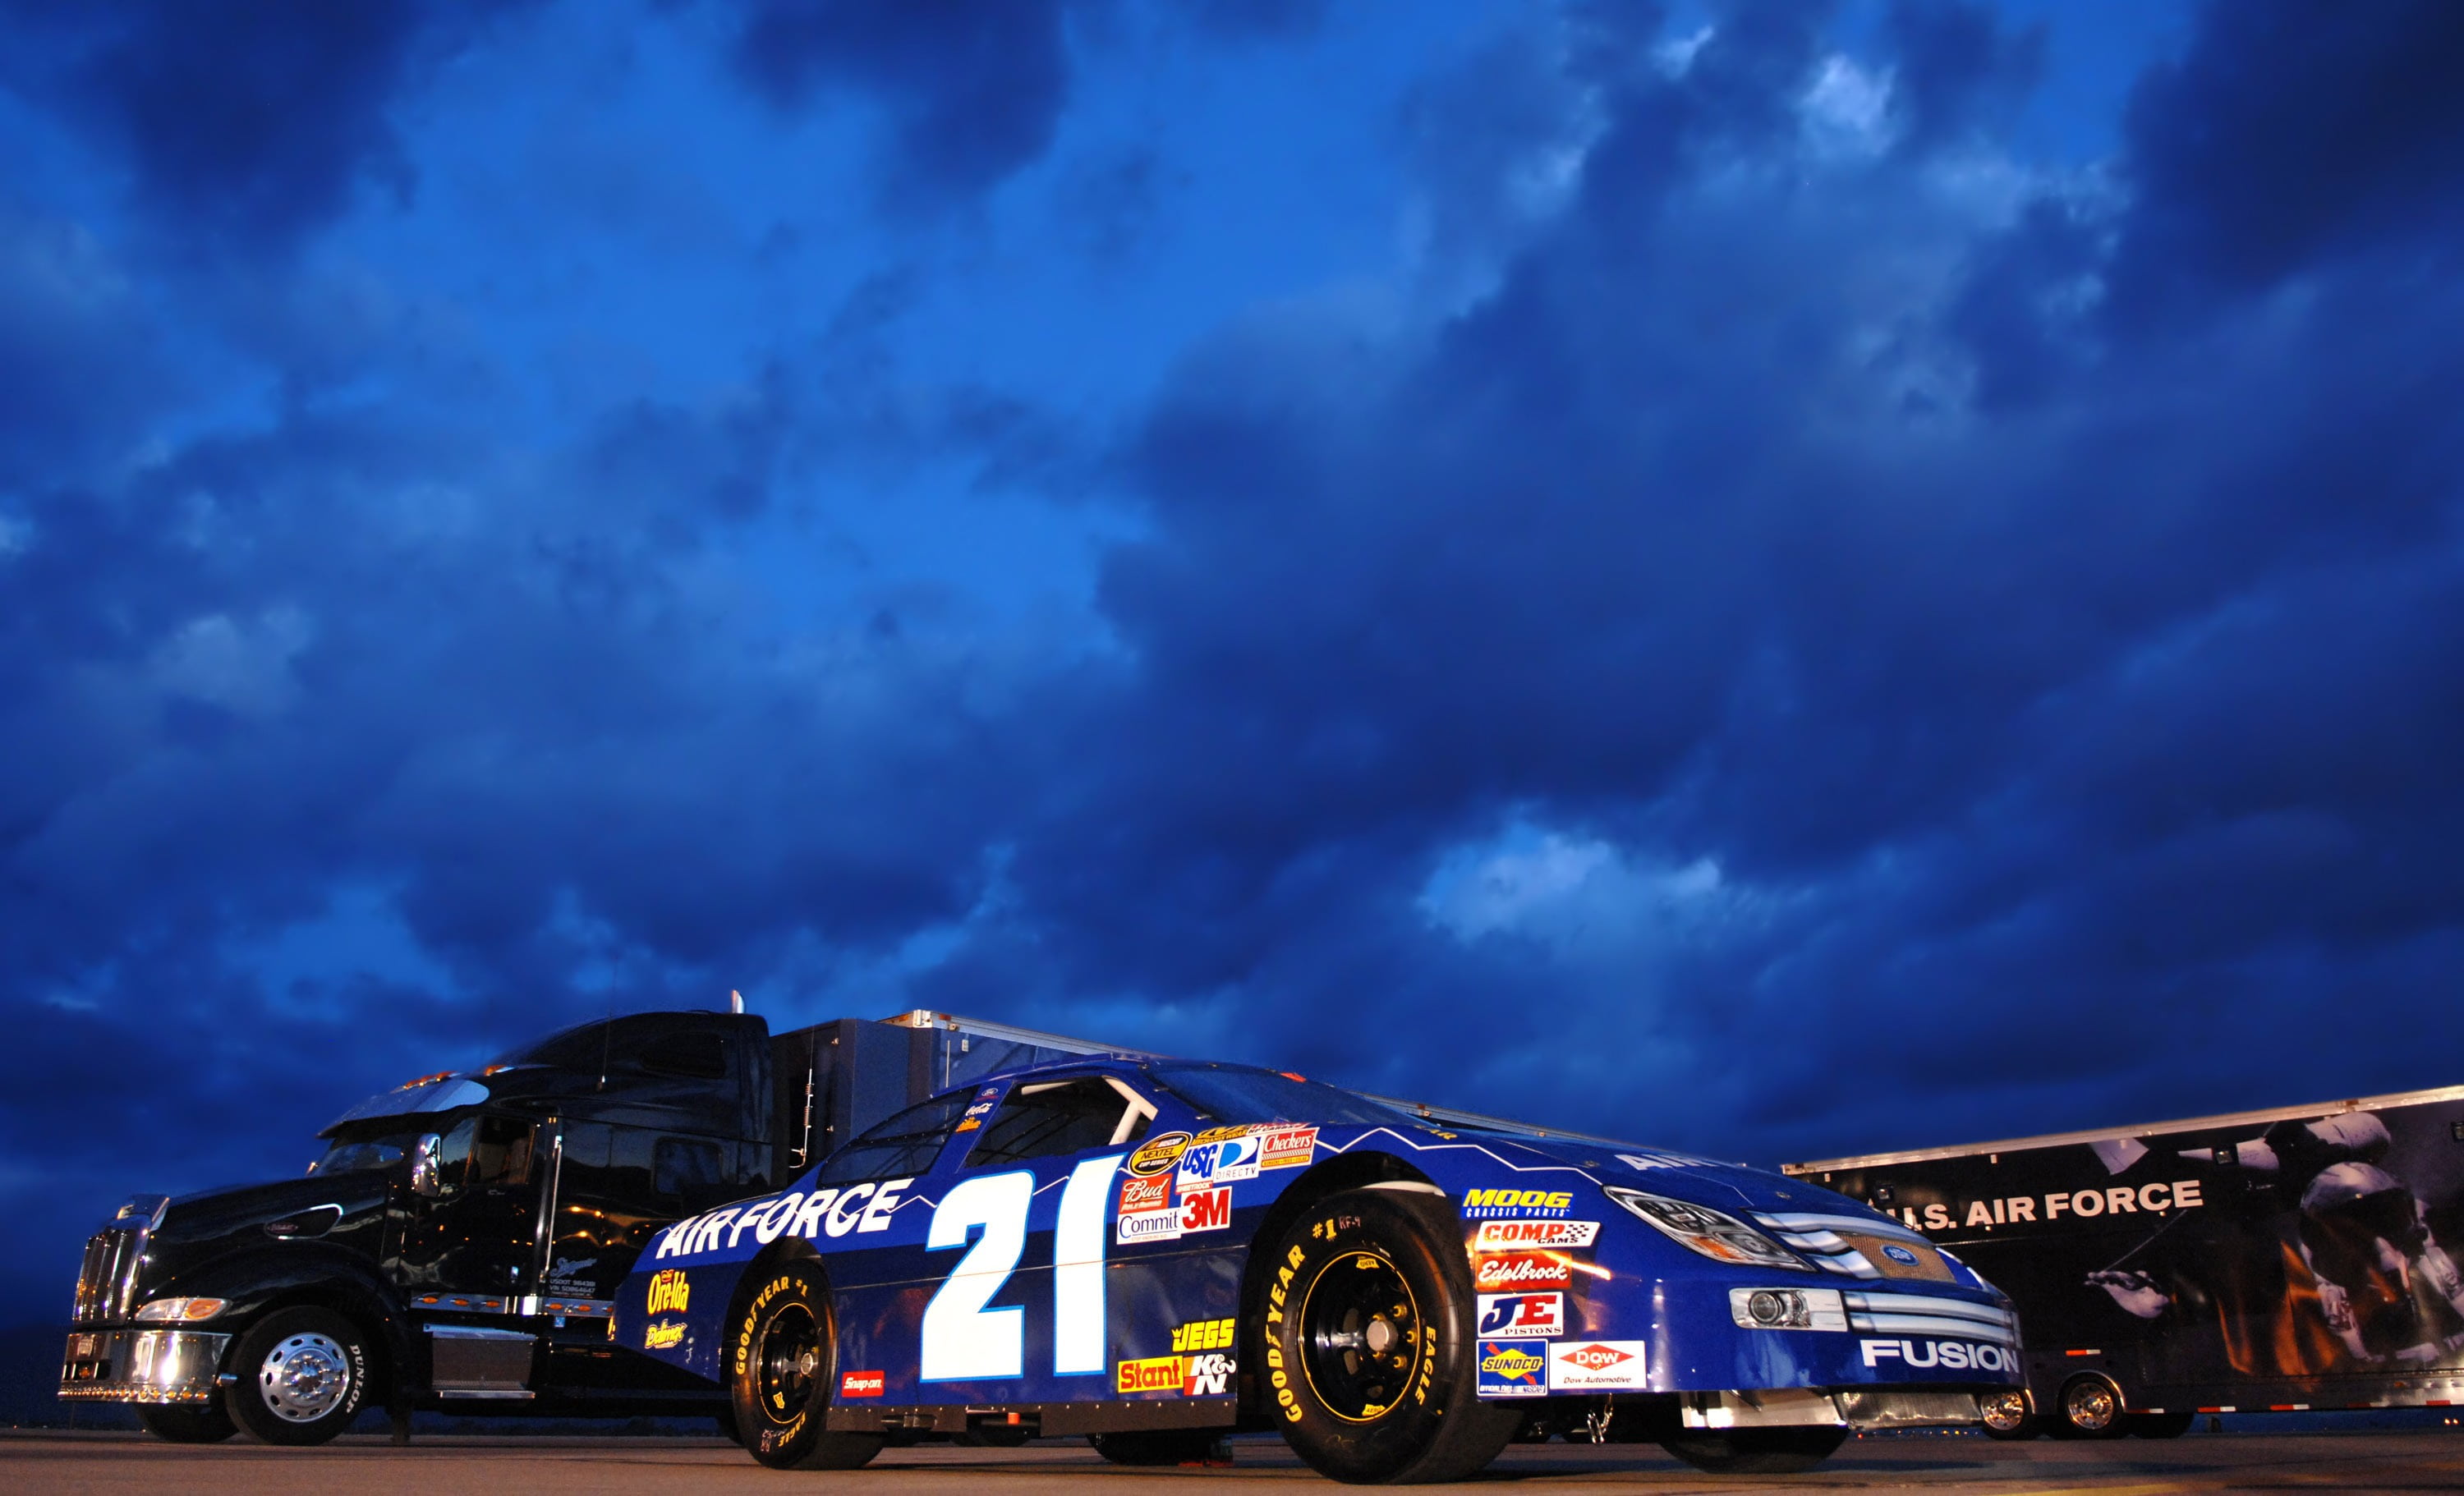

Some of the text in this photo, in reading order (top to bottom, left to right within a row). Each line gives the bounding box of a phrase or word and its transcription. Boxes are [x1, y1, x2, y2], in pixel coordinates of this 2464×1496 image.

[1141, 1148, 1175, 1160] NEXTEL
[1264, 1132, 1312, 1153] Checkers
[1183, 1144, 1218, 1178] USG
[1216, 1167, 1257, 1180] DIRECTV
[1123, 1177, 1170, 1203] Bud
[1463, 1189, 1573, 1208] MOOG
[1965, 1196, 2037, 1228] AIR
[2045, 1180, 2203, 1219] FORCE
[655, 1178, 915, 1260] AIR FORCE
[1119, 1211, 1178, 1238] Commit
[1182, 1188, 1230, 1230] 3M
[1466, 1207, 1565, 1218] CHASSIS PARTS
[1484, 1223, 1565, 1241] COMP
[919, 1152, 1129, 1383] 21
[1478, 1259, 1568, 1283] Edelbrock
[735, 1276, 790, 1375] GOODYEAR
[1480, 1295, 1556, 1333] JE
[1172, 1319, 1236, 1352] JEGS
[1265, 1245, 1306, 1423] GOODYEAR
[1505, 1327, 1561, 1335] PISTONS
[1415, 1326, 1437, 1406] EAGLE
[1484, 1358, 1541, 1370] SUNOCO
[1859, 1339, 2020, 1374] FUSION
[347, 1344, 365, 1413] DUNLOP
[1120, 1360, 1181, 1389] Stant
[1564, 1376, 1631, 1384] Dow Automotive
[777, 1411, 807, 1448] EAGLE
